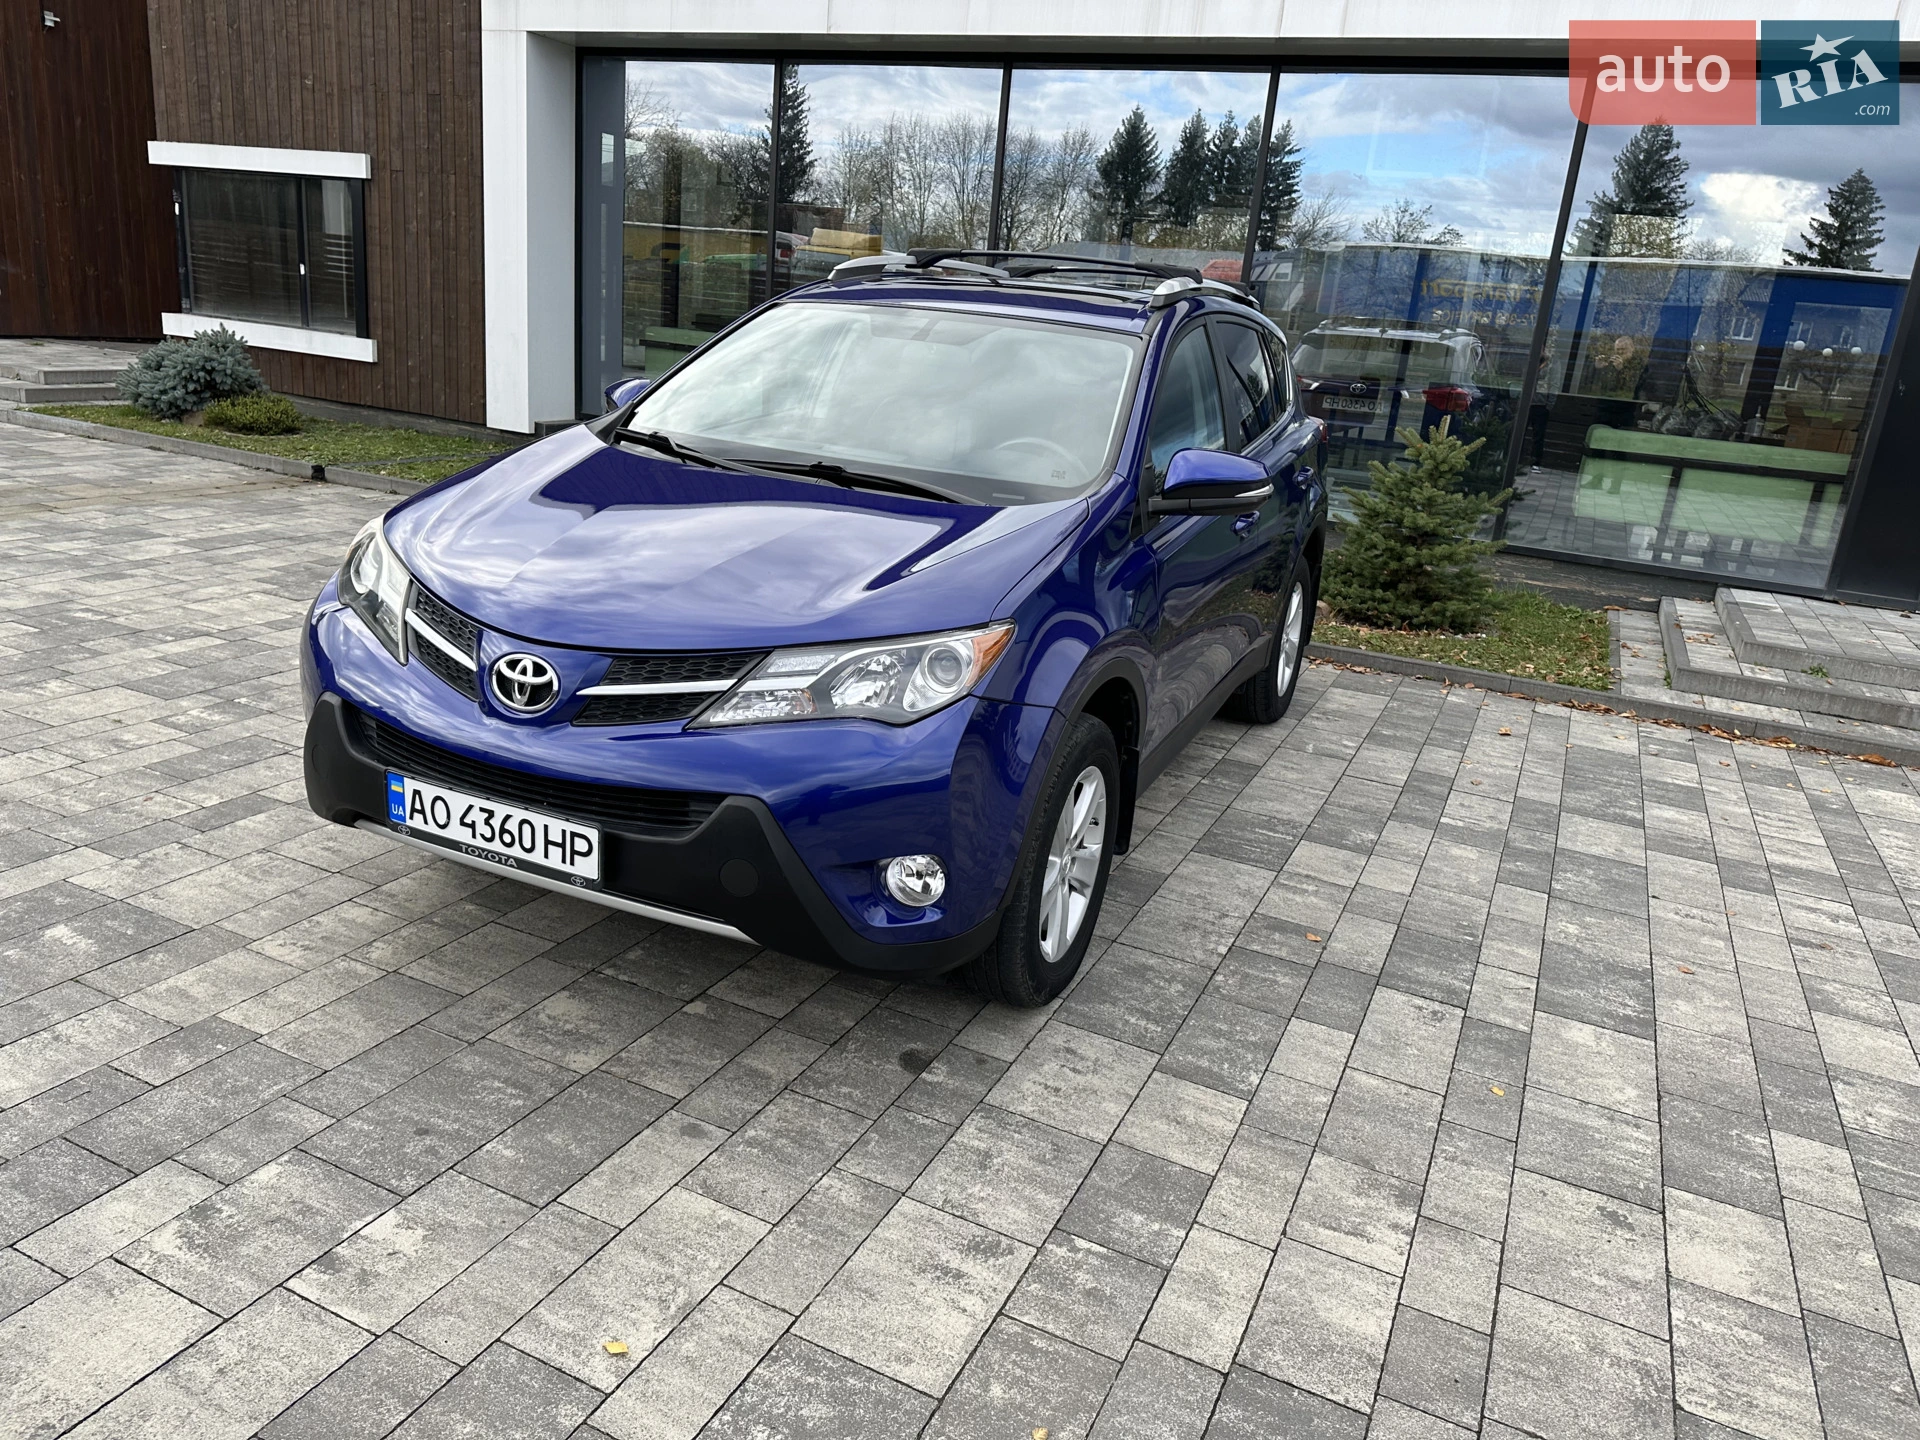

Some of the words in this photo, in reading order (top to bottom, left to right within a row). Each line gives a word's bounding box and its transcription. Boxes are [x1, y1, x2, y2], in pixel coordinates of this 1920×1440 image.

[392, 804, 405, 817] UA
[409, 788, 451, 830] AO
[459, 804, 536, 854] 4360
[543, 824, 594, 867] HP
[459, 844, 518, 868] TOYOTA
